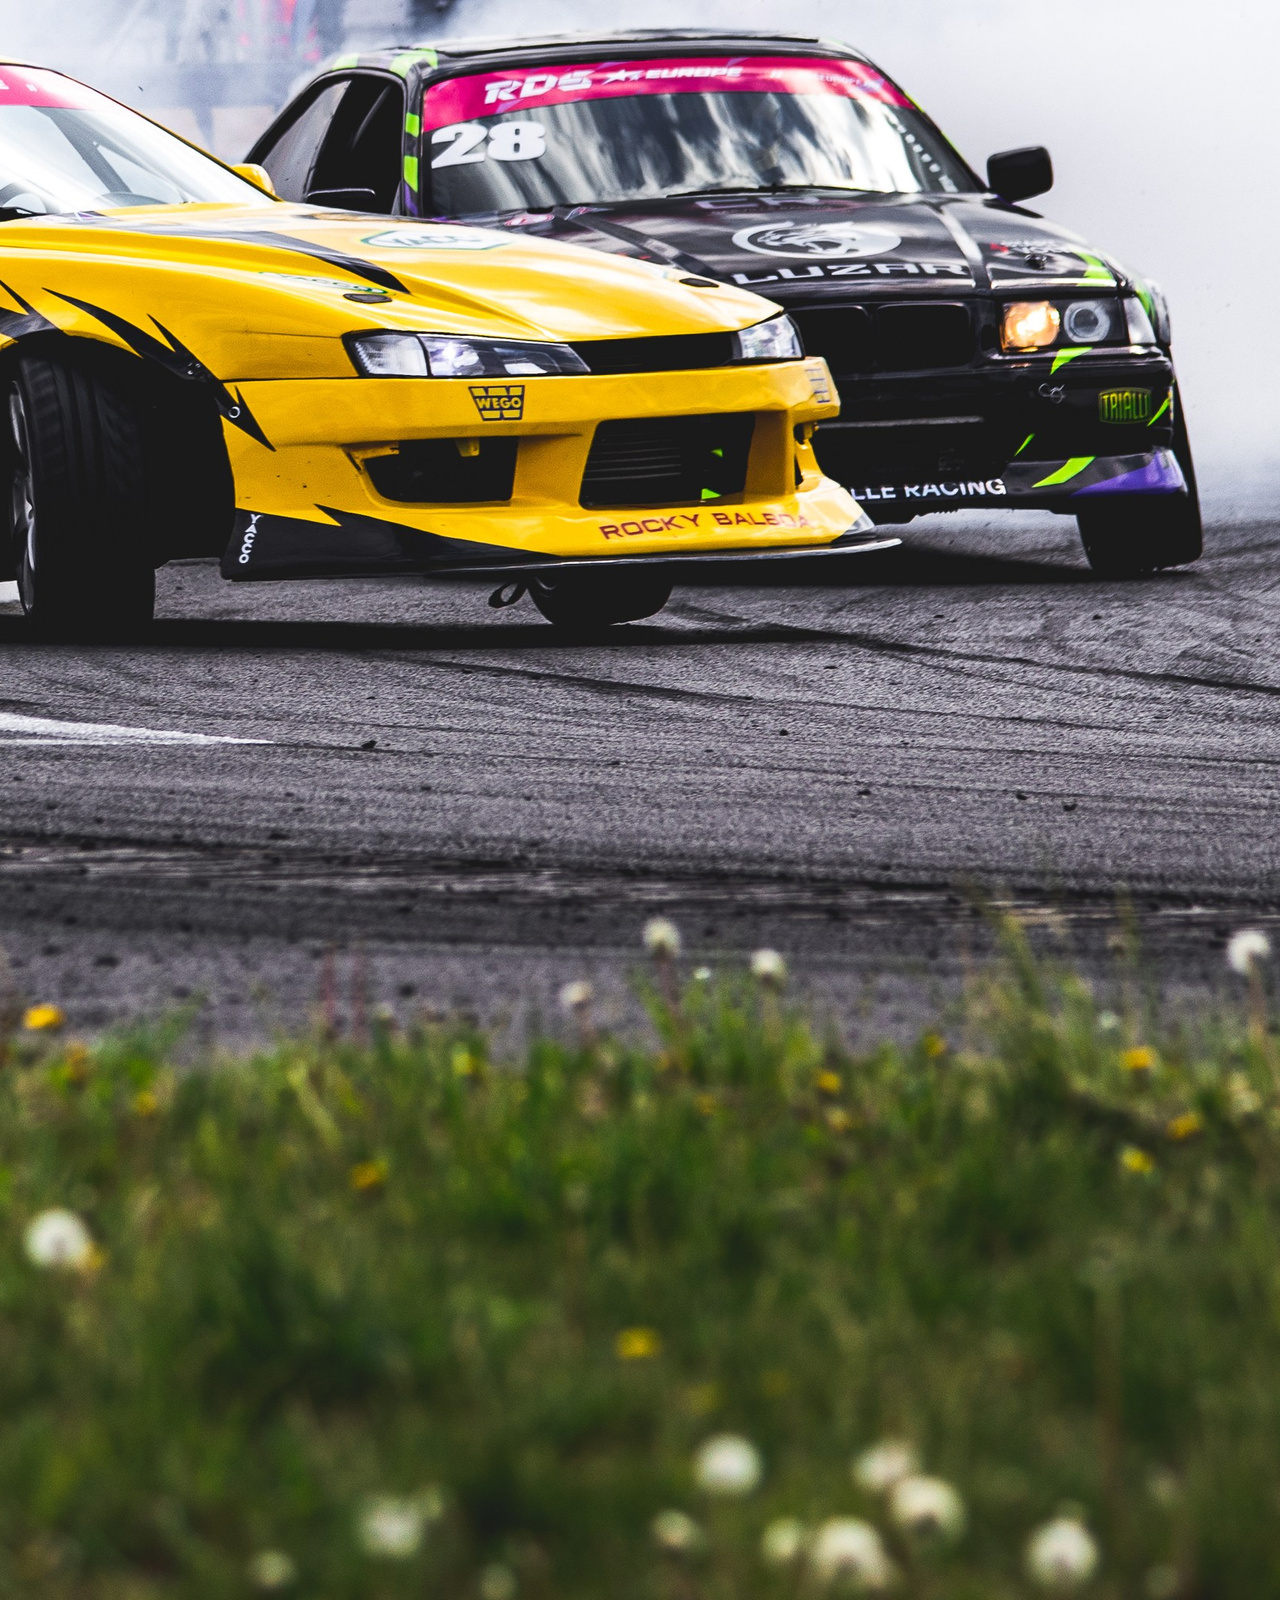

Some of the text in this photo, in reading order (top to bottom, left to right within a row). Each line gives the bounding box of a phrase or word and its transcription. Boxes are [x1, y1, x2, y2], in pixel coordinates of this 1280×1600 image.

[484, 66, 743, 105] RDS EUROPE
[430, 121, 547, 169] 28
[731, 263, 969, 285] LUZAR
[476, 397, 522, 409] WEGO
[850, 478, 1007, 500] LLE RACING
[238, 513, 264, 564] YACCO
[598, 511, 814, 540] ROCKY BALBOA
